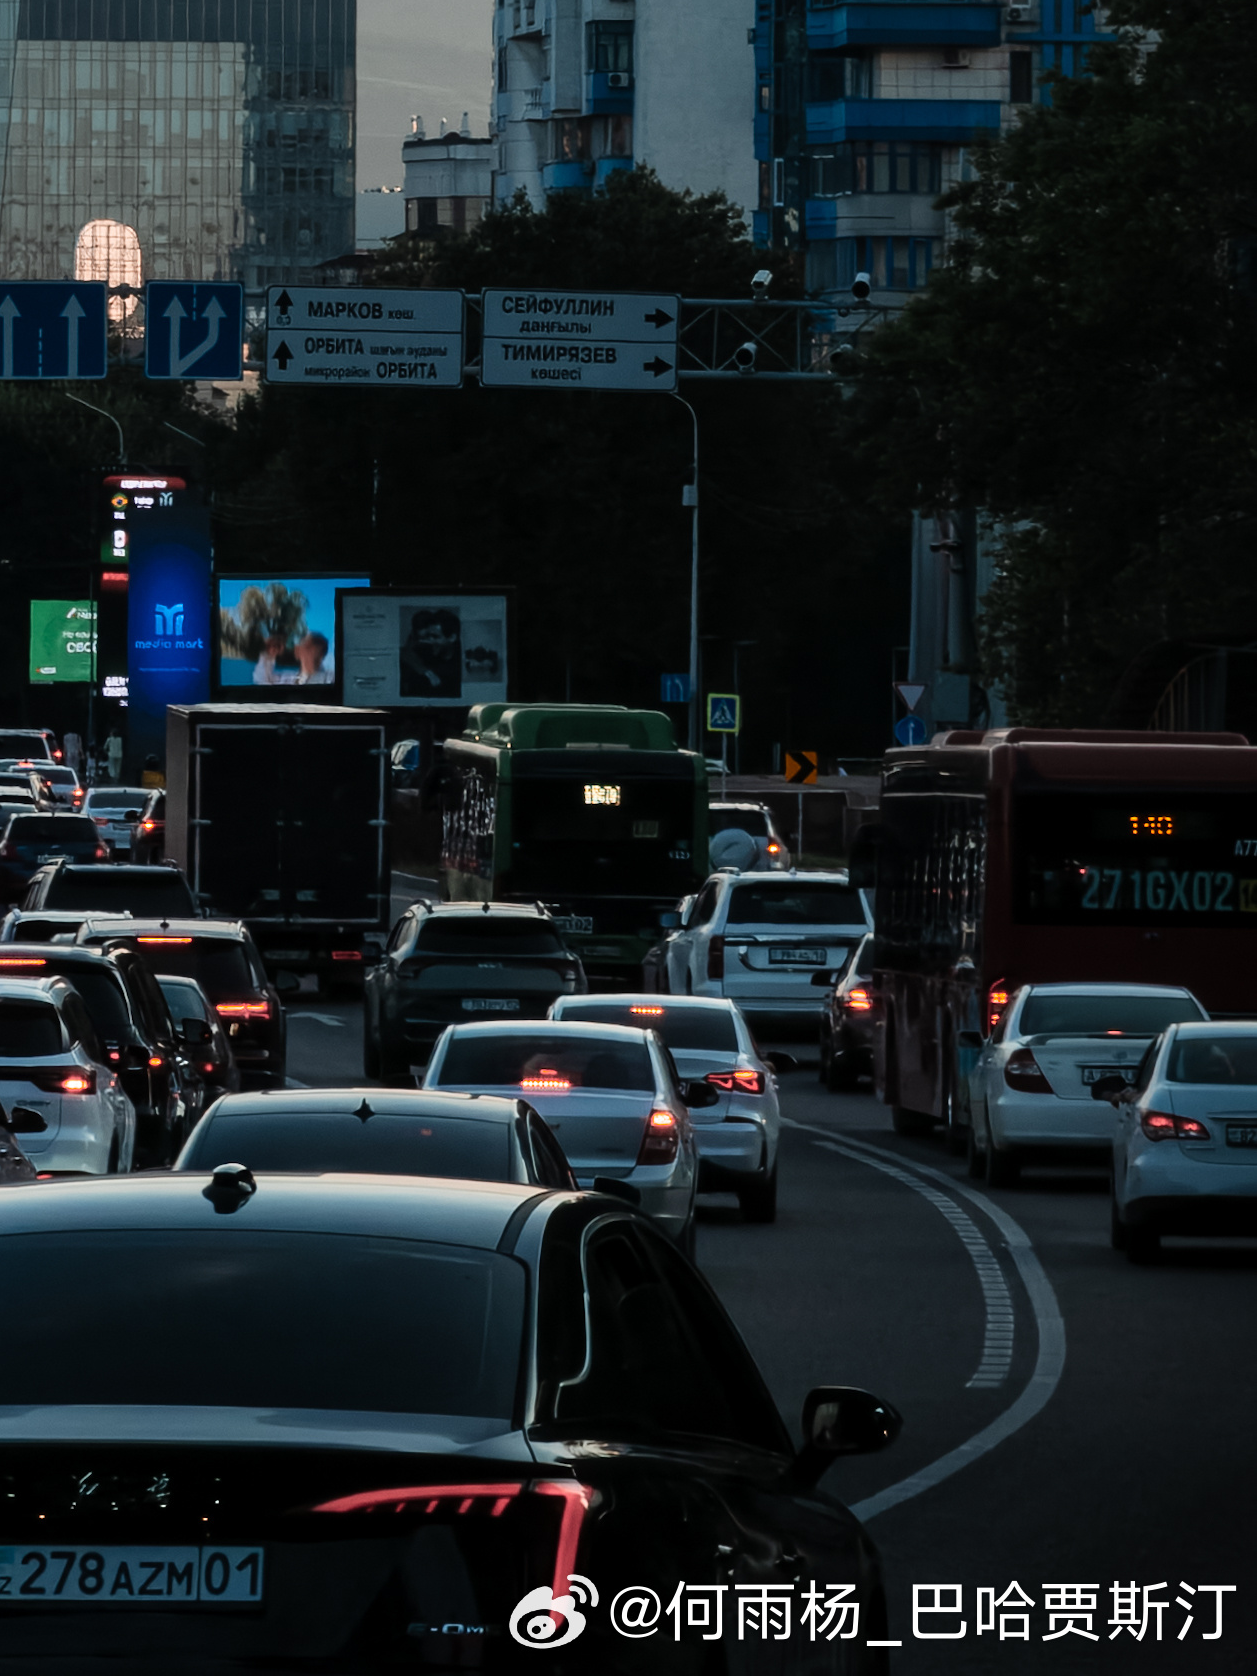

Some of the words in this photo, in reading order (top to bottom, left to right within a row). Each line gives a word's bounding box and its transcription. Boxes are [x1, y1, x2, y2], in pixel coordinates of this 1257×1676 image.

[308, 300, 383, 319] МАРКОВ
[501, 295, 614, 316] СЕЙФУЛЛИН
[304, 337, 364, 355] ОРБИТА
[501, 344, 617, 364] ТИМИРЯЗЕВ
[376, 362, 438, 379] ОРБИТА
[531, 367, 581, 380] көшесі
[135, 638, 172, 649] media
[175, 637, 204, 649] mart
[1081, 866, 1234, 912] 271GX02
